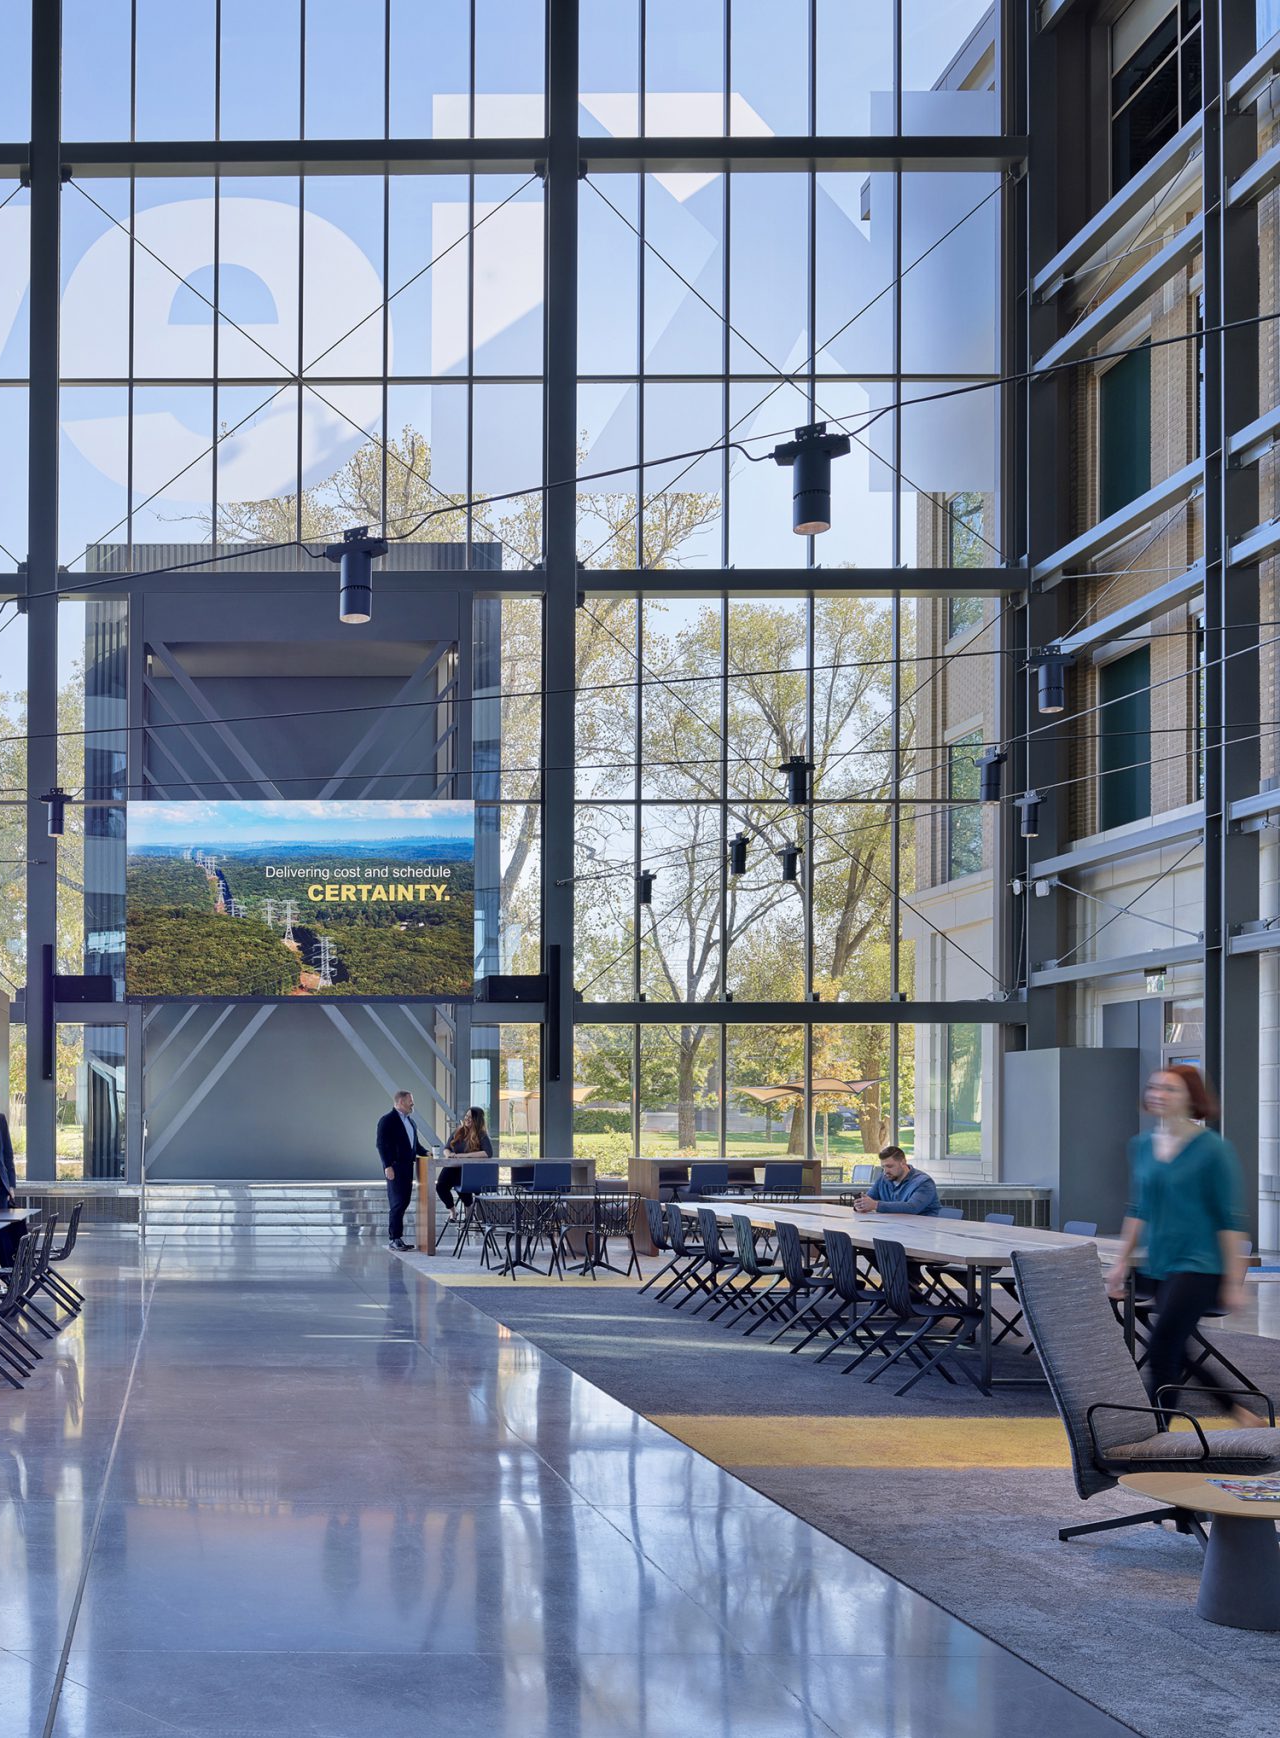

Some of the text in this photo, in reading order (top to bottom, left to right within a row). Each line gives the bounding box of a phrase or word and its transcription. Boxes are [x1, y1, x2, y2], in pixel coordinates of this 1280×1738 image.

[265, 866, 451, 880] Delivering cost and schedule
[307, 884, 451, 902] CERTAINTY.
